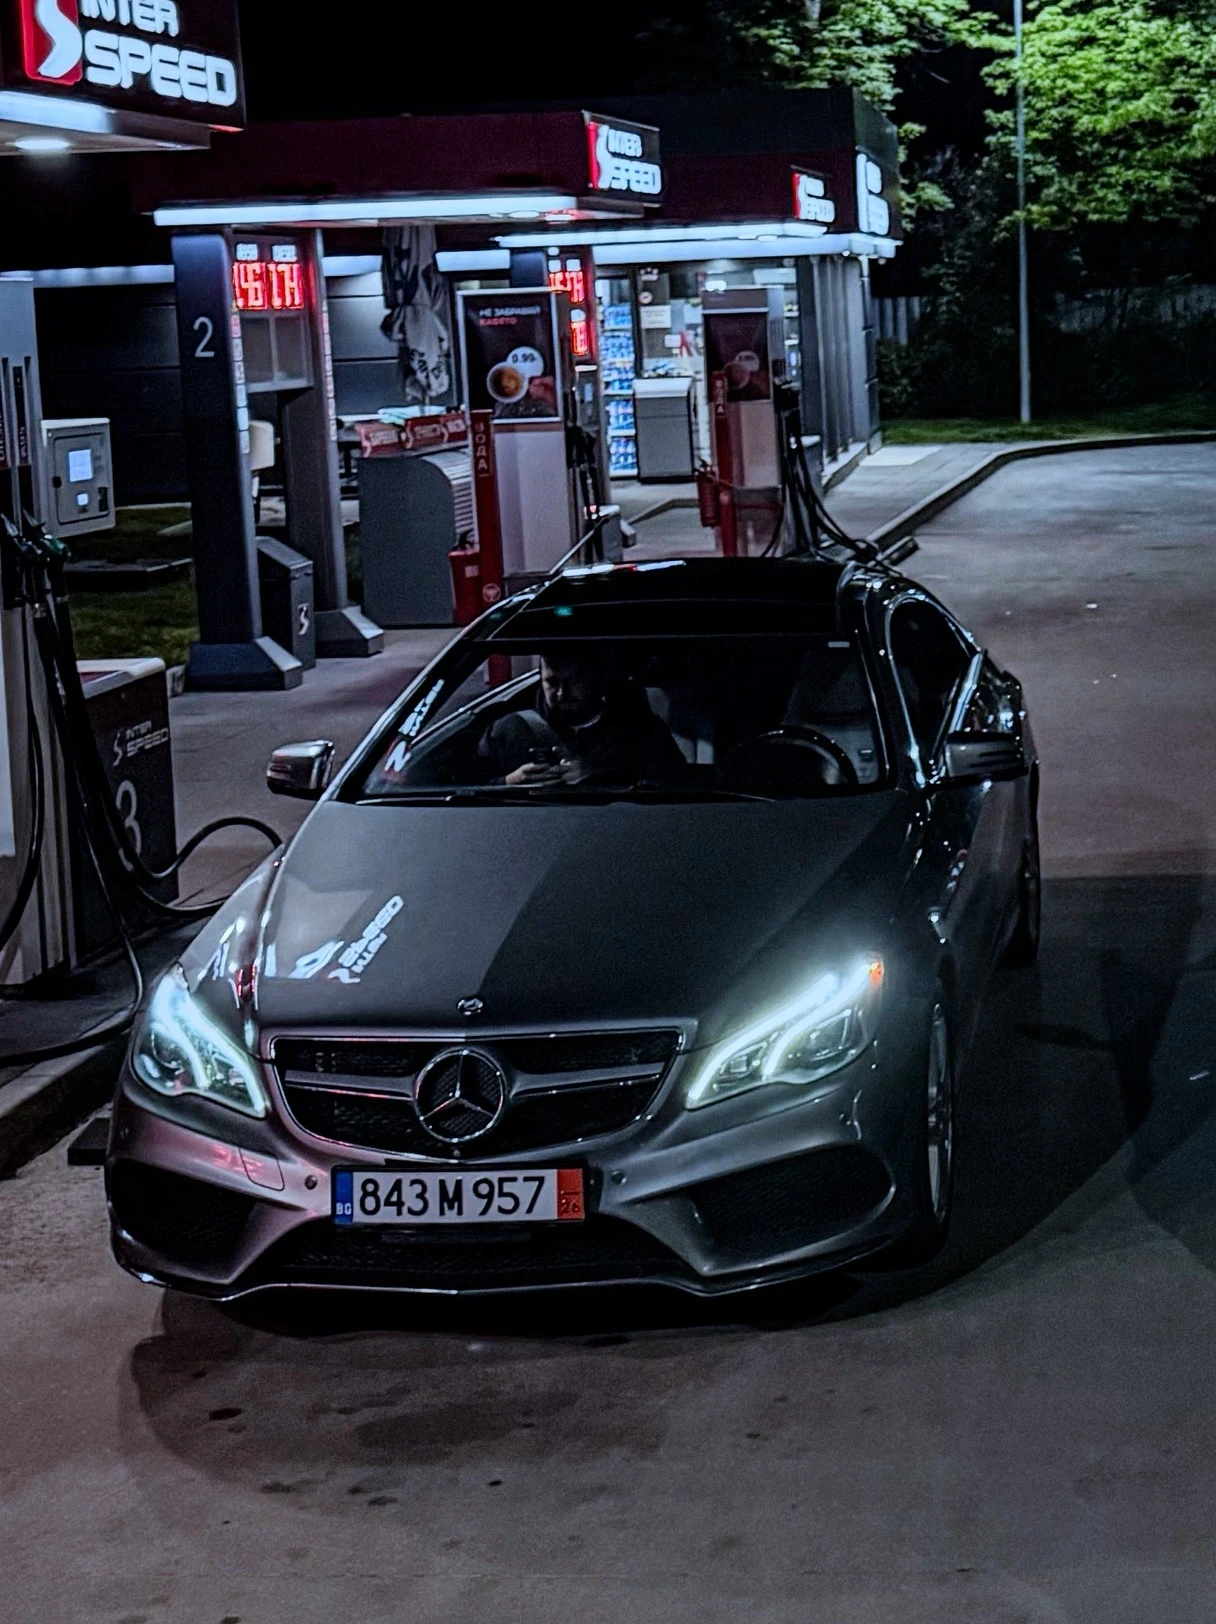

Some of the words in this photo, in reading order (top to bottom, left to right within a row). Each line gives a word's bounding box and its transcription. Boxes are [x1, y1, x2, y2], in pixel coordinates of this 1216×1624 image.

[84, 29, 237, 107] SPEED
[193, 317, 215, 358] 2
[115, 780, 142, 872] 3
[335, 1202, 352, 1215] BG
[359, 1178, 429, 1216] 843
[439, 1176, 464, 1216] M
[473, 1176, 546, 1216] 957
